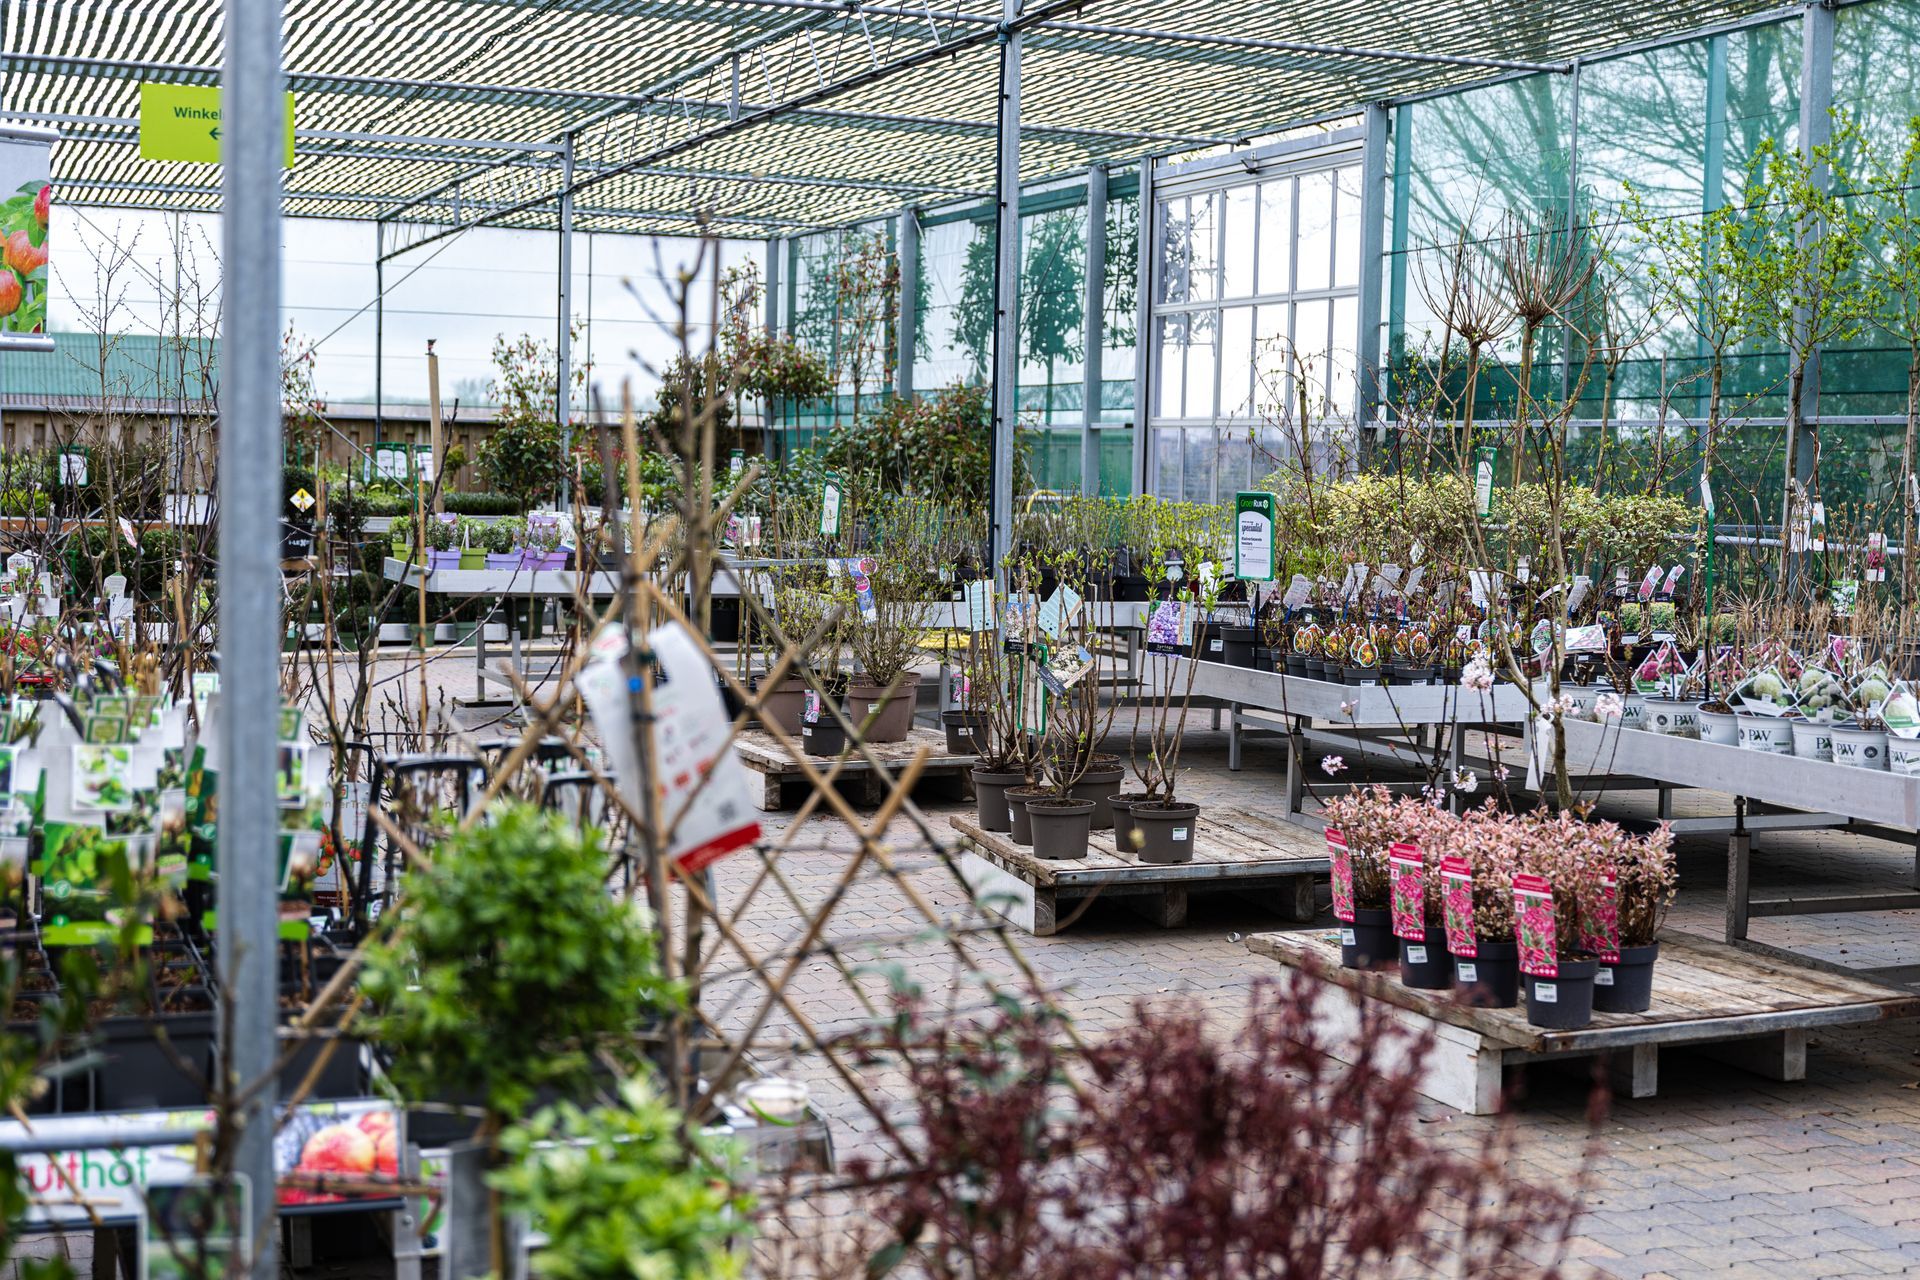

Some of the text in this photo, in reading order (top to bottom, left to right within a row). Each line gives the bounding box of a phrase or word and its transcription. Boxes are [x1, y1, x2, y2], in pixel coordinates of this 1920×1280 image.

[1674, 714, 1697, 726] PW
[1748, 729, 1772, 741] PW
[1836, 743, 1857, 756] PW
